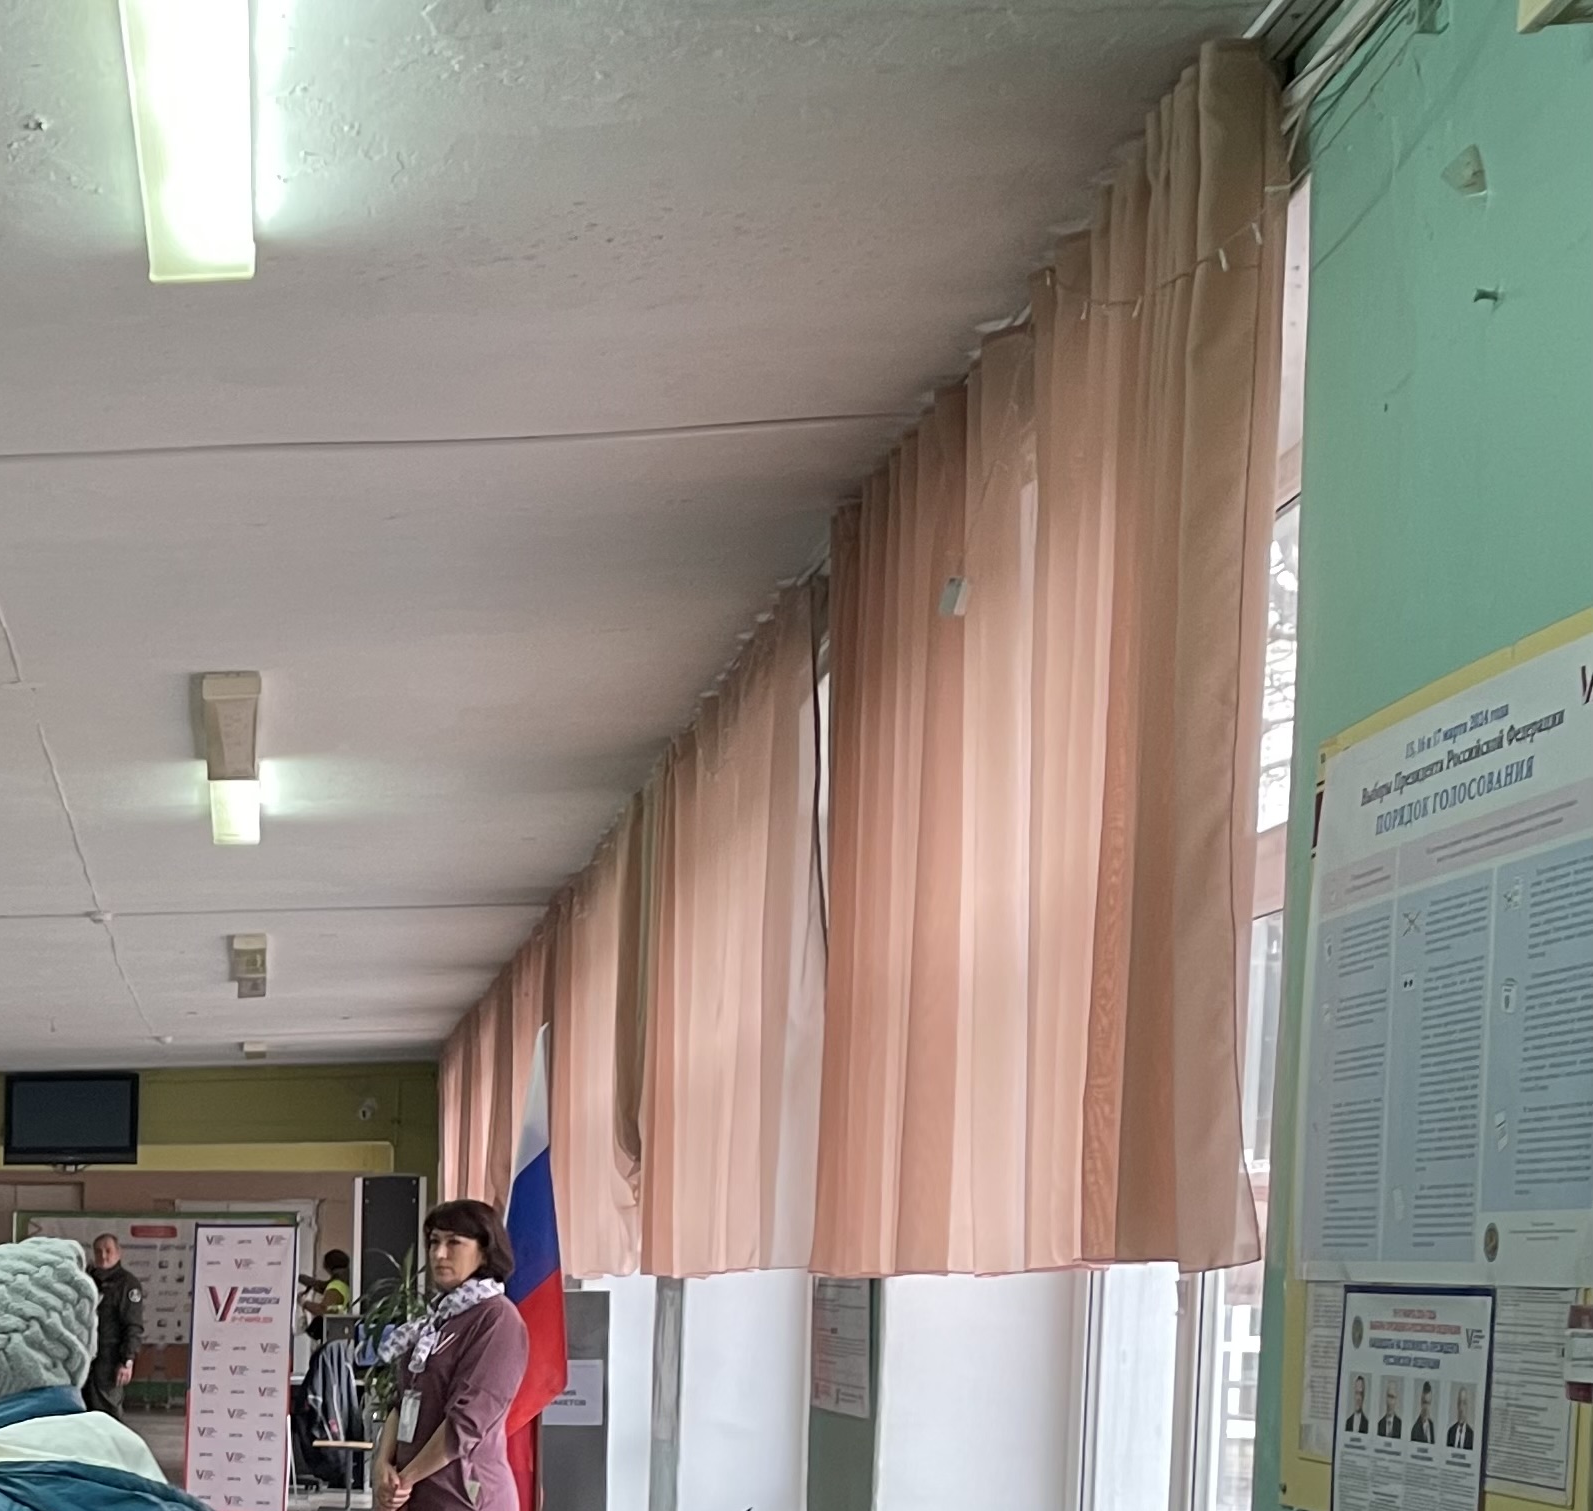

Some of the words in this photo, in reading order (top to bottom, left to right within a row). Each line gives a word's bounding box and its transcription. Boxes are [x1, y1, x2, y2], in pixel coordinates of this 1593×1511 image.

[1361, 780, 1394, 807] Выборы
[1393, 759, 1444, 796] Президента
[1446, 729, 1505, 771] Российской
[1507, 708, 1566, 745] Федерации
[1443, 722, 1468, 745] марта
[1469, 709, 1489, 733] 2024
[1375, 796, 1431, 836] ПОРЯДОК
[1432, 755, 1535, 815] ГОЛОСОВАНИЯ
